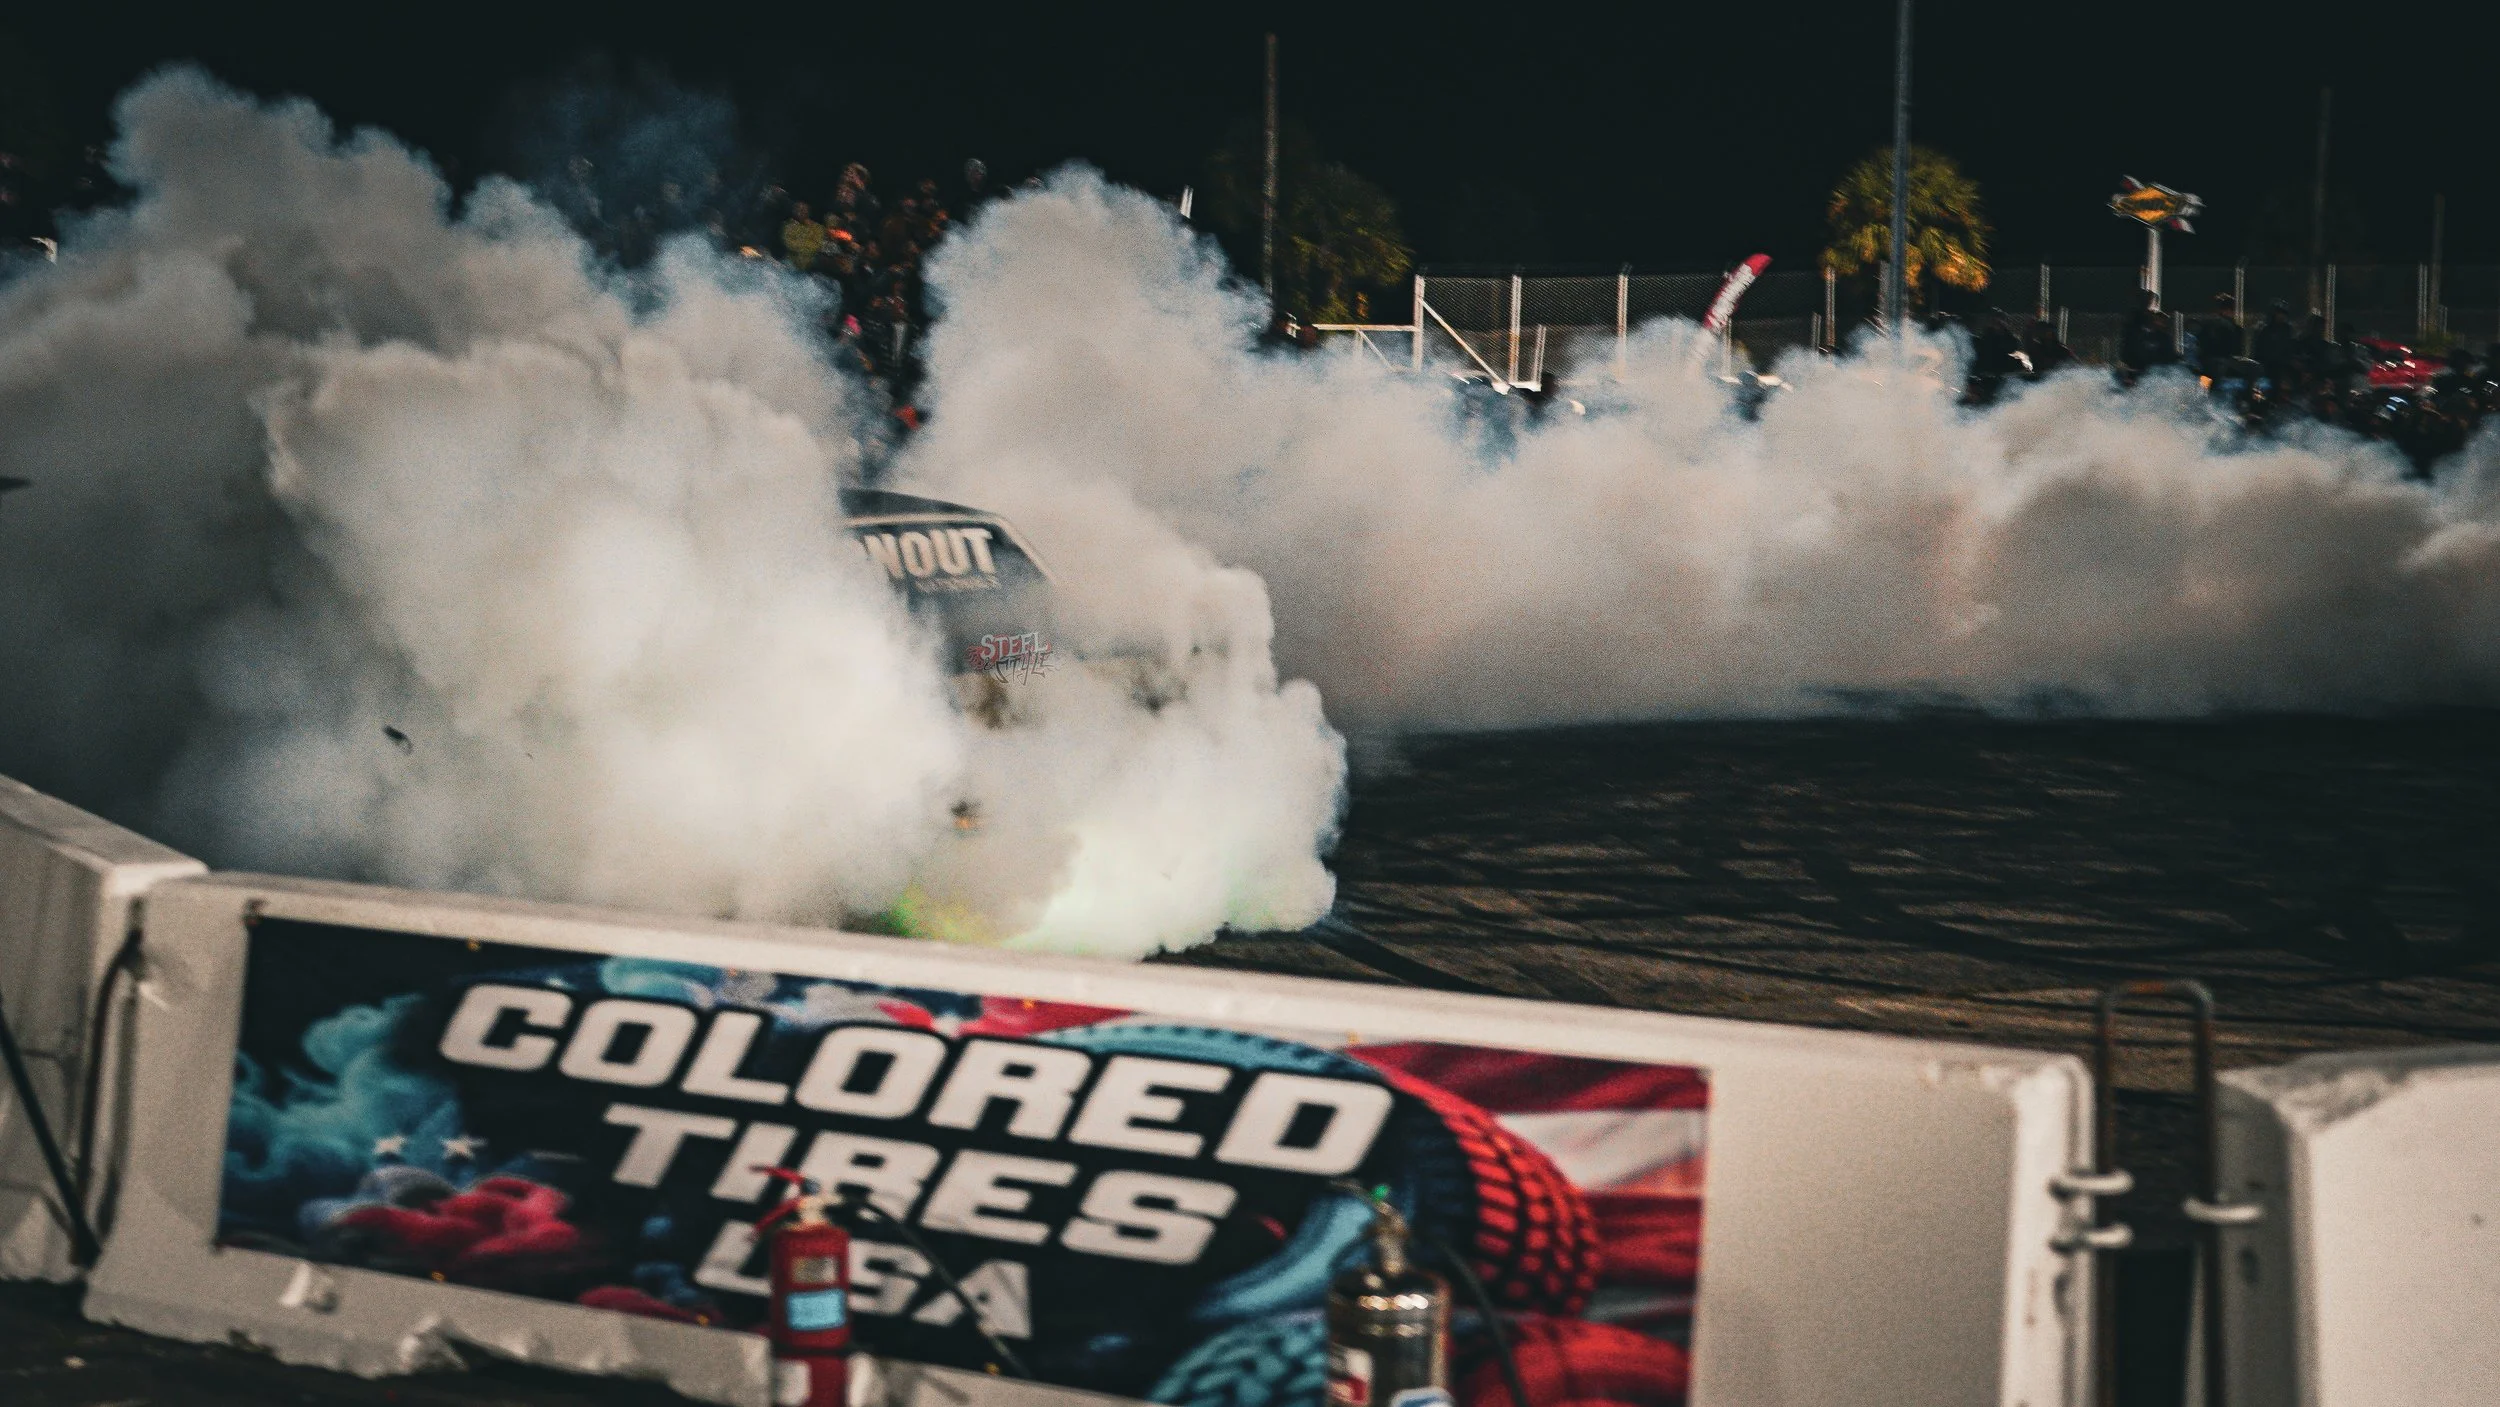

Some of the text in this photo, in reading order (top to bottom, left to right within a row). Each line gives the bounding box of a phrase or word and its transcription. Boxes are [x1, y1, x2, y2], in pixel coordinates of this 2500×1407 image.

[863, 528, 996, 580] NOUT
[438, 983, 1393, 1176] COLORED
[604, 1103, 1239, 1265] TIRES
